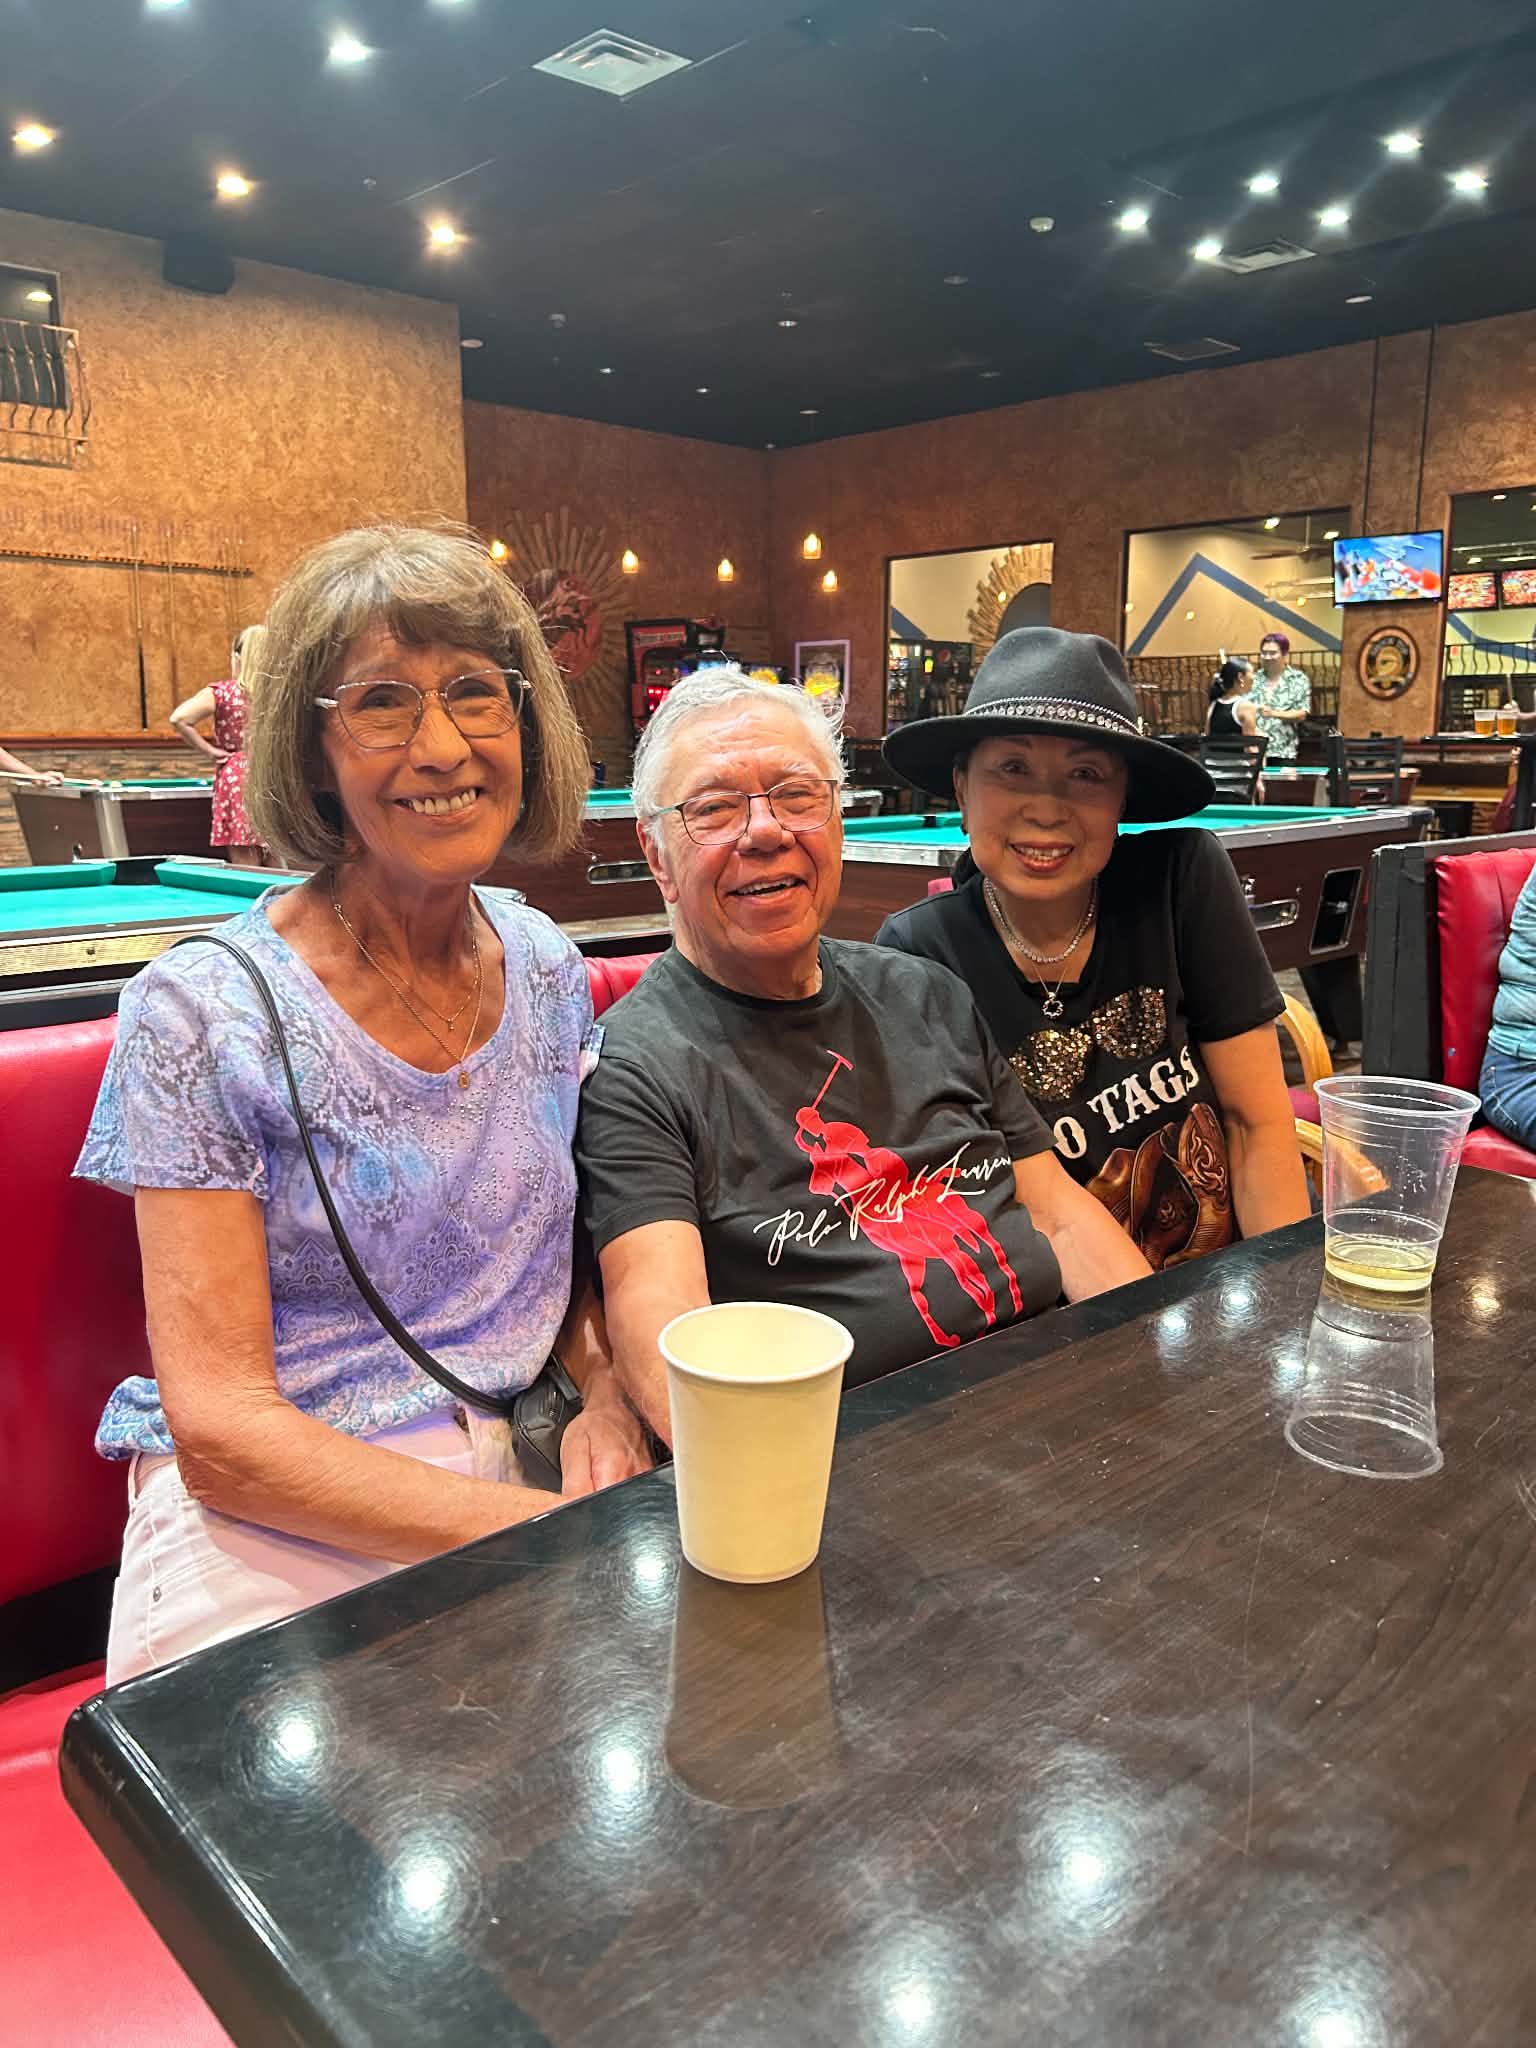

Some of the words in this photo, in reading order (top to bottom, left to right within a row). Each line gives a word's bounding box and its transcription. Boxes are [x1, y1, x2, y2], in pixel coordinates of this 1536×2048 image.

[1086, 1045, 1199, 1134] TAGS
[753, 1208, 842, 1266] Polo
[834, 1164, 929, 1240] Ralph
[925, 1141, 1012, 1203] Lauren
